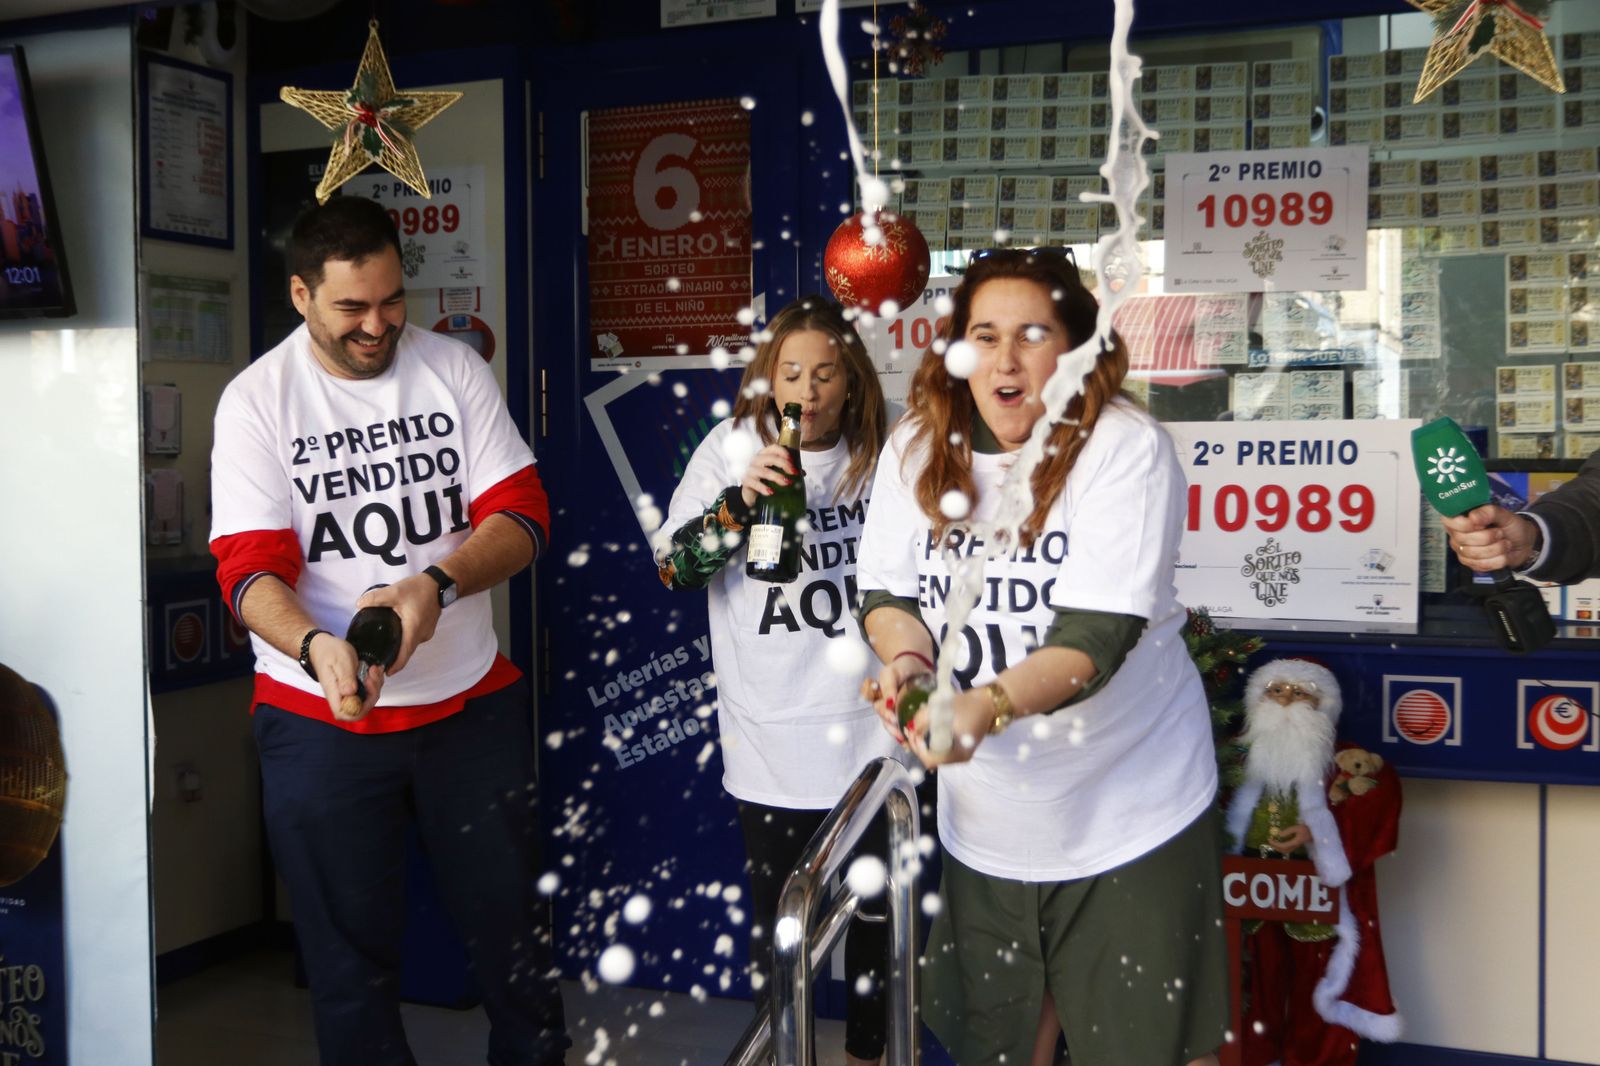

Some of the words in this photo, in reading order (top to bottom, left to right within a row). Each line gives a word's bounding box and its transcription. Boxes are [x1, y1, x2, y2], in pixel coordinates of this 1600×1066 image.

[632, 132, 701, 231] 6
[1208, 164, 1231, 182] 2º
[1238, 160, 1323, 181] PREMIO
[372, 182, 388, 199] 2º
[386, 203, 460, 236] 0989
[1197, 191, 1334, 229] 10989
[621, 232, 717, 258] ENERO
[4, 266, 41, 285] 12:01
[644, 262, 696, 275] SORTEO
[614, 280, 724, 296] EXTRAOINARIO
[635, 303, 651, 314] DE
[655, 302, 671, 313] EL
[675, 299, 705, 313] NIÑO
[1192, 440, 1225, 466] 2º
[1236, 439, 1359, 466] PREMIO
[292, 447, 461, 505] VENDIDO
[307, 477, 472, 567] AQUÍ
[1241, 551, 1302, 578] SORTEO
[1249, 581, 1289, 608] UNE
[587, 646, 690, 708] Loterías
[692, 634, 711, 663] y
[602, 671, 715, 737] Apuestas
[612, 718, 700, 770] Estado
[1223, 872, 1333, 912] COME
